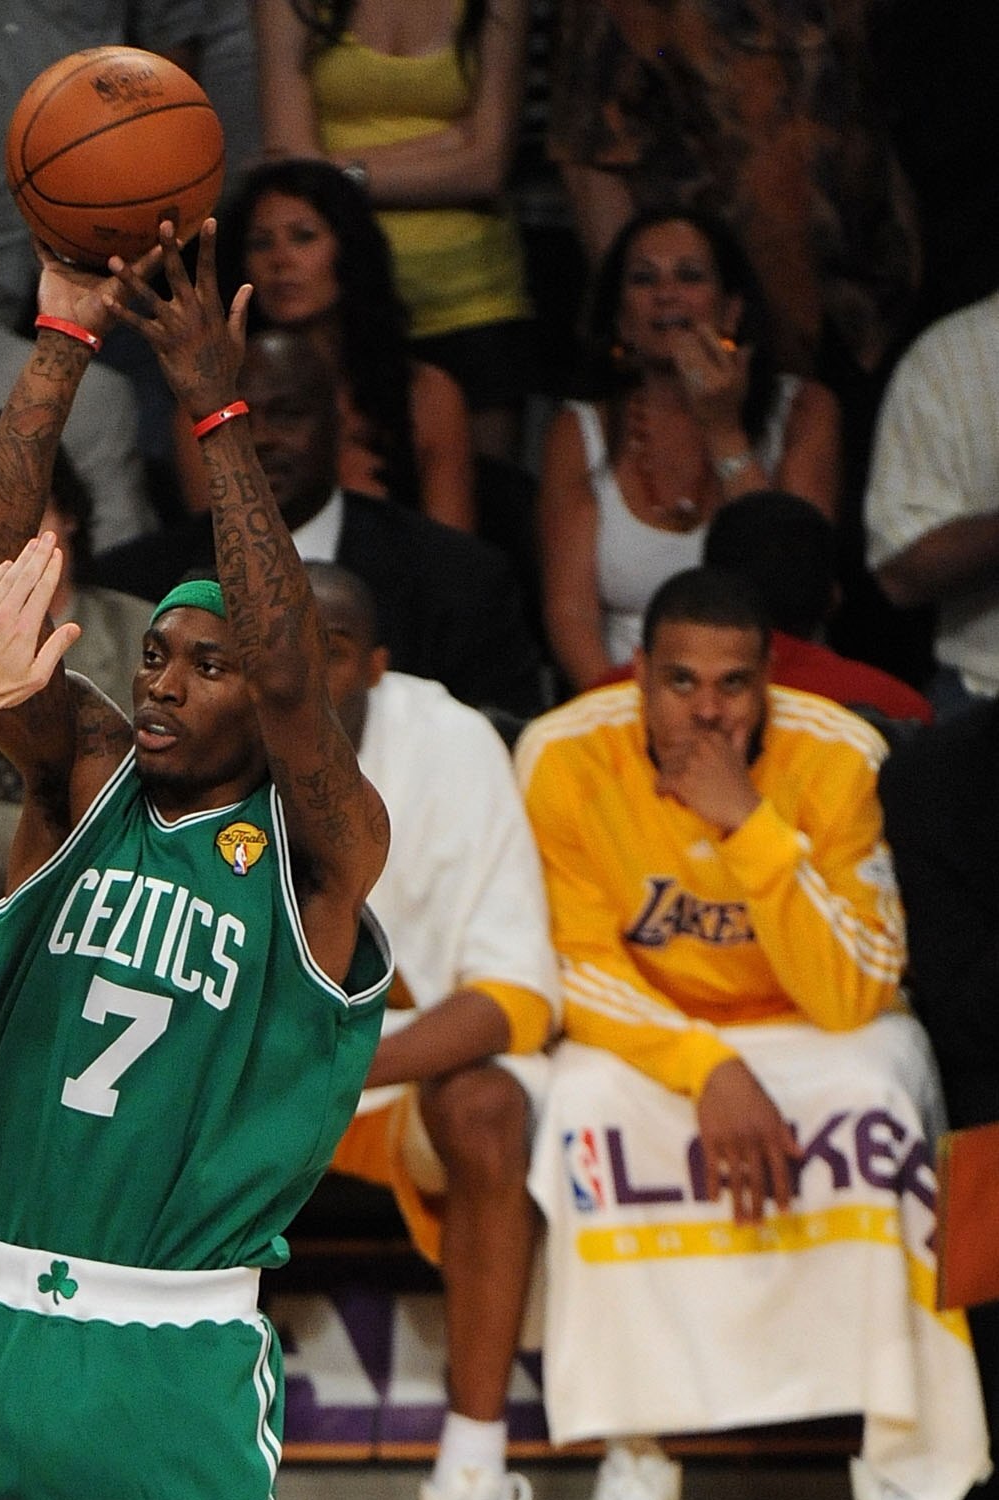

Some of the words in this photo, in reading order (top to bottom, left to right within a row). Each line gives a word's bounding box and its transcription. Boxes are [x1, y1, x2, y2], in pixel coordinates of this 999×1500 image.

[230, 829, 266, 845] Finals
[48, 868, 246, 1011] CELTICS
[623, 876, 758, 949] LAKE
[61, 975, 173, 1117] 7
